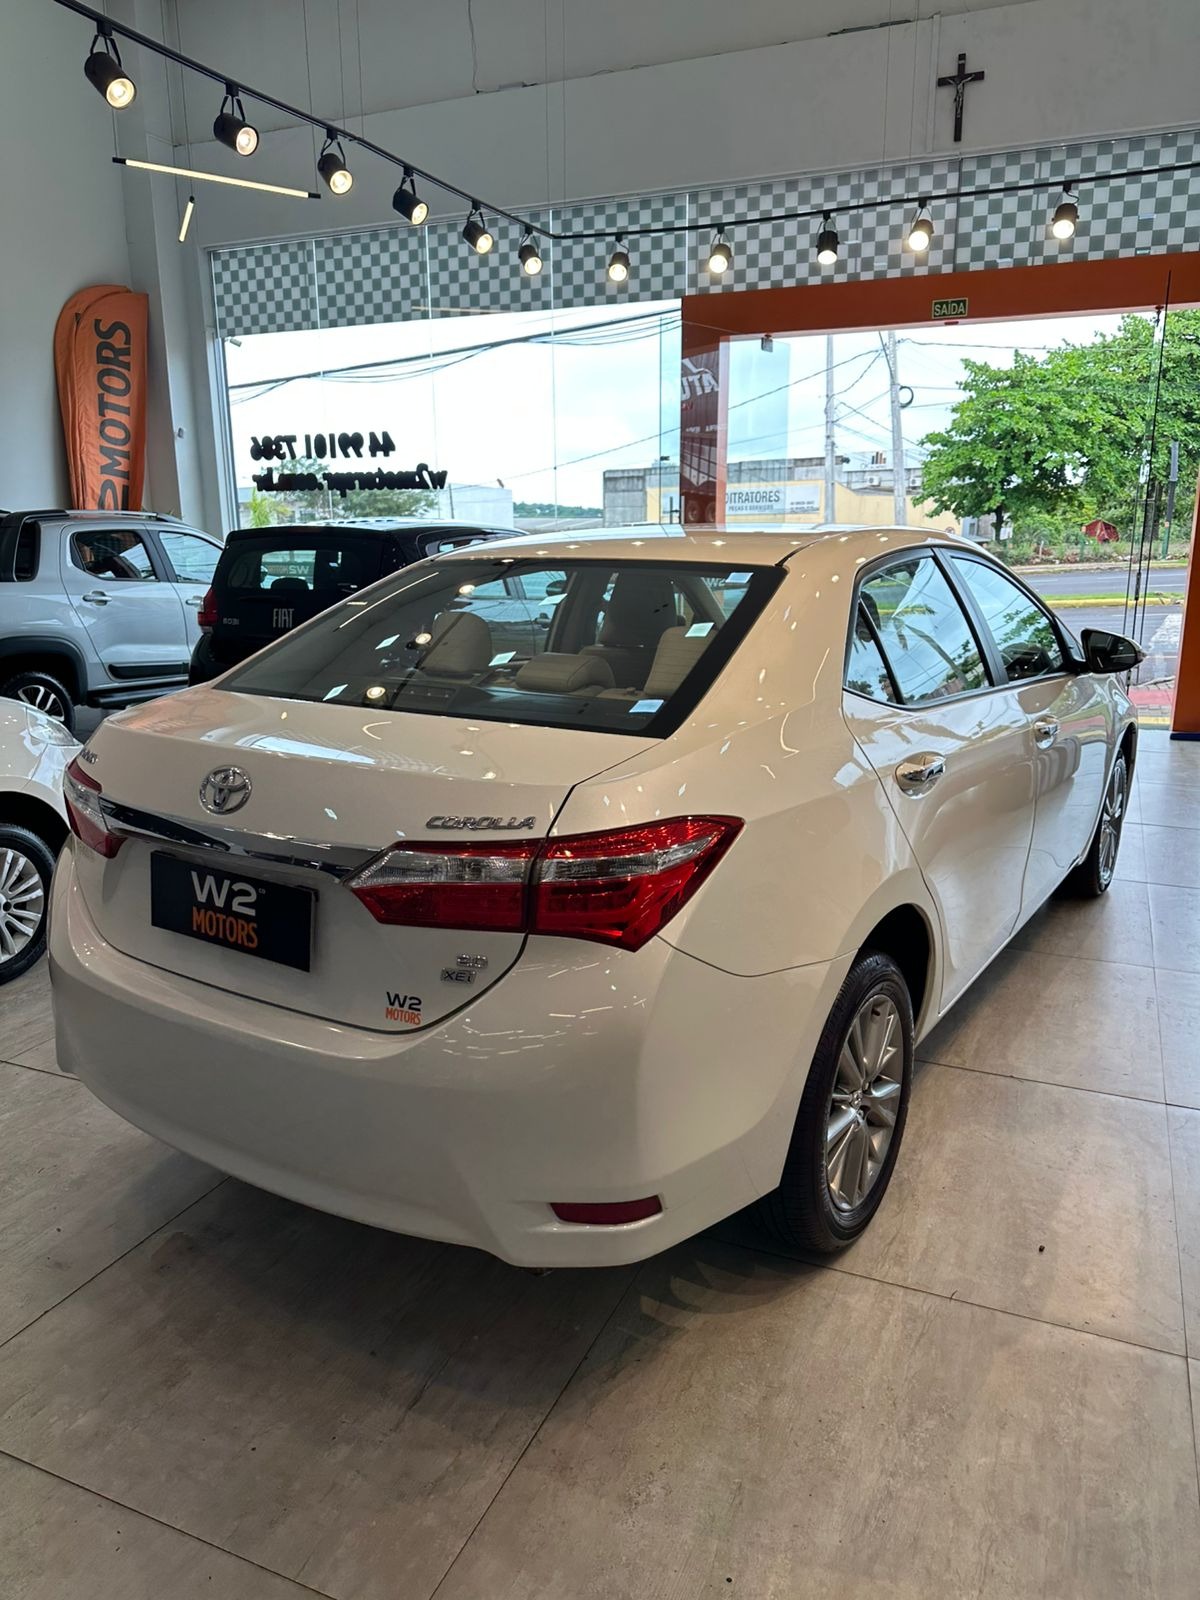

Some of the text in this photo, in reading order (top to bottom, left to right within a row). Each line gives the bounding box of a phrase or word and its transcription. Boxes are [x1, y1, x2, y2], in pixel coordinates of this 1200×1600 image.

[934, 301, 965, 316] SAÍDA
[273, 608, 294, 628] FIAT
[426, 816, 537, 830] COROLLA
[191, 870, 258, 917] W2
[192, 906, 259, 949] MOTORS
[386, 991, 422, 1012] W2
[385, 1007, 422, 1026] MOTORS
